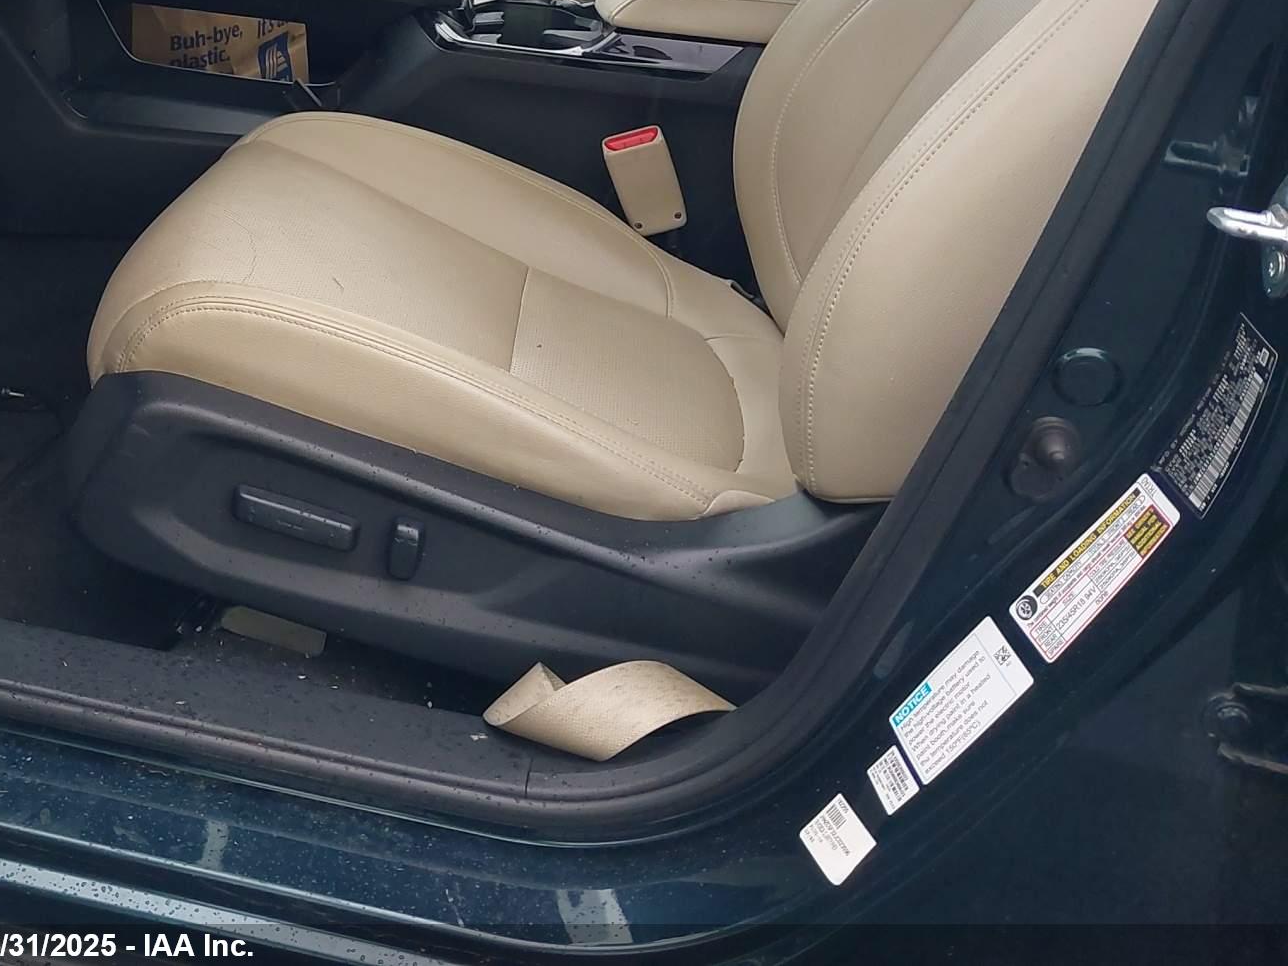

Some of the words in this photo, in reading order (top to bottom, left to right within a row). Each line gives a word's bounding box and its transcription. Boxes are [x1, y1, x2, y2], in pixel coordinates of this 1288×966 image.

[169, 24, 244, 51] Buh-bye,
[1041, 572, 1056, 588] TIRE
[1055, 558, 1070, 575] AND
[1069, 531, 1097, 562] LOADING
[1095, 491, 1136, 535] INFORMATION
[912, 684, 945, 719] temperature
[944, 672, 957, 686] may
[956, 648, 980, 674] damage
[944, 675, 965, 697] battery
[964, 660, 979, 677] used
[953, 681, 971, 699] motor
[893, 685, 929, 724] NOTICE
[928, 716, 947, 737] drying
[945, 702, 960, 720] paint
[969, 672, 991, 695] heated
[976, 699, 988, 712] not
